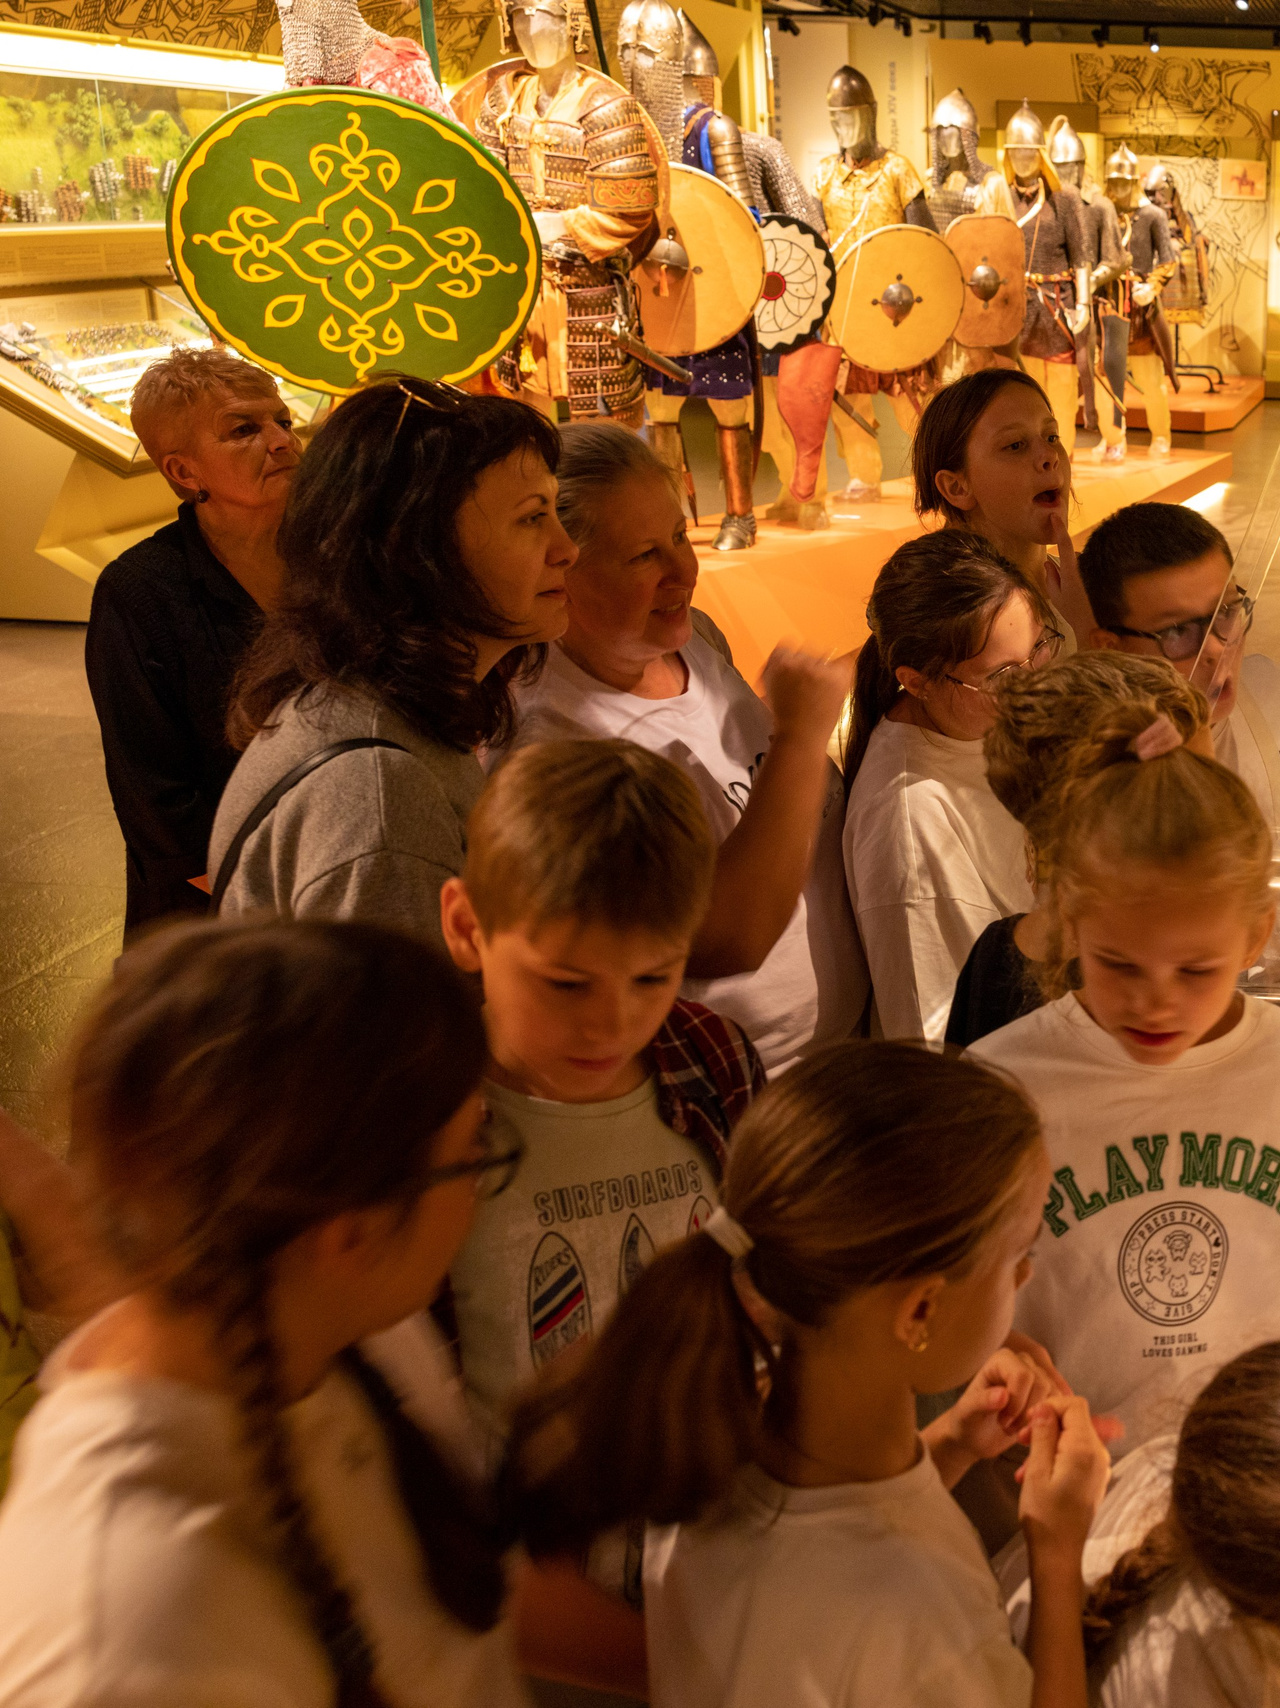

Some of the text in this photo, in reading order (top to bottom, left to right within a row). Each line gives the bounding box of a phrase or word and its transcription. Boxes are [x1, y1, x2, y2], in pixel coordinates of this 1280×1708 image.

[533, 1159, 703, 1227] SURFBOARDS
[1042, 1133, 1169, 1238] PLAY
[1138, 1210, 1217, 1241] PRESS START
[1206, 1252, 1221, 1292] DON'T
[1130, 1281, 1144, 1298] UP
[1164, 1303, 1194, 1318] GIVE
[1142, 1343, 1208, 1358] LOVES GAMING
[1153, 1332, 1199, 1346] THIS GIRL
